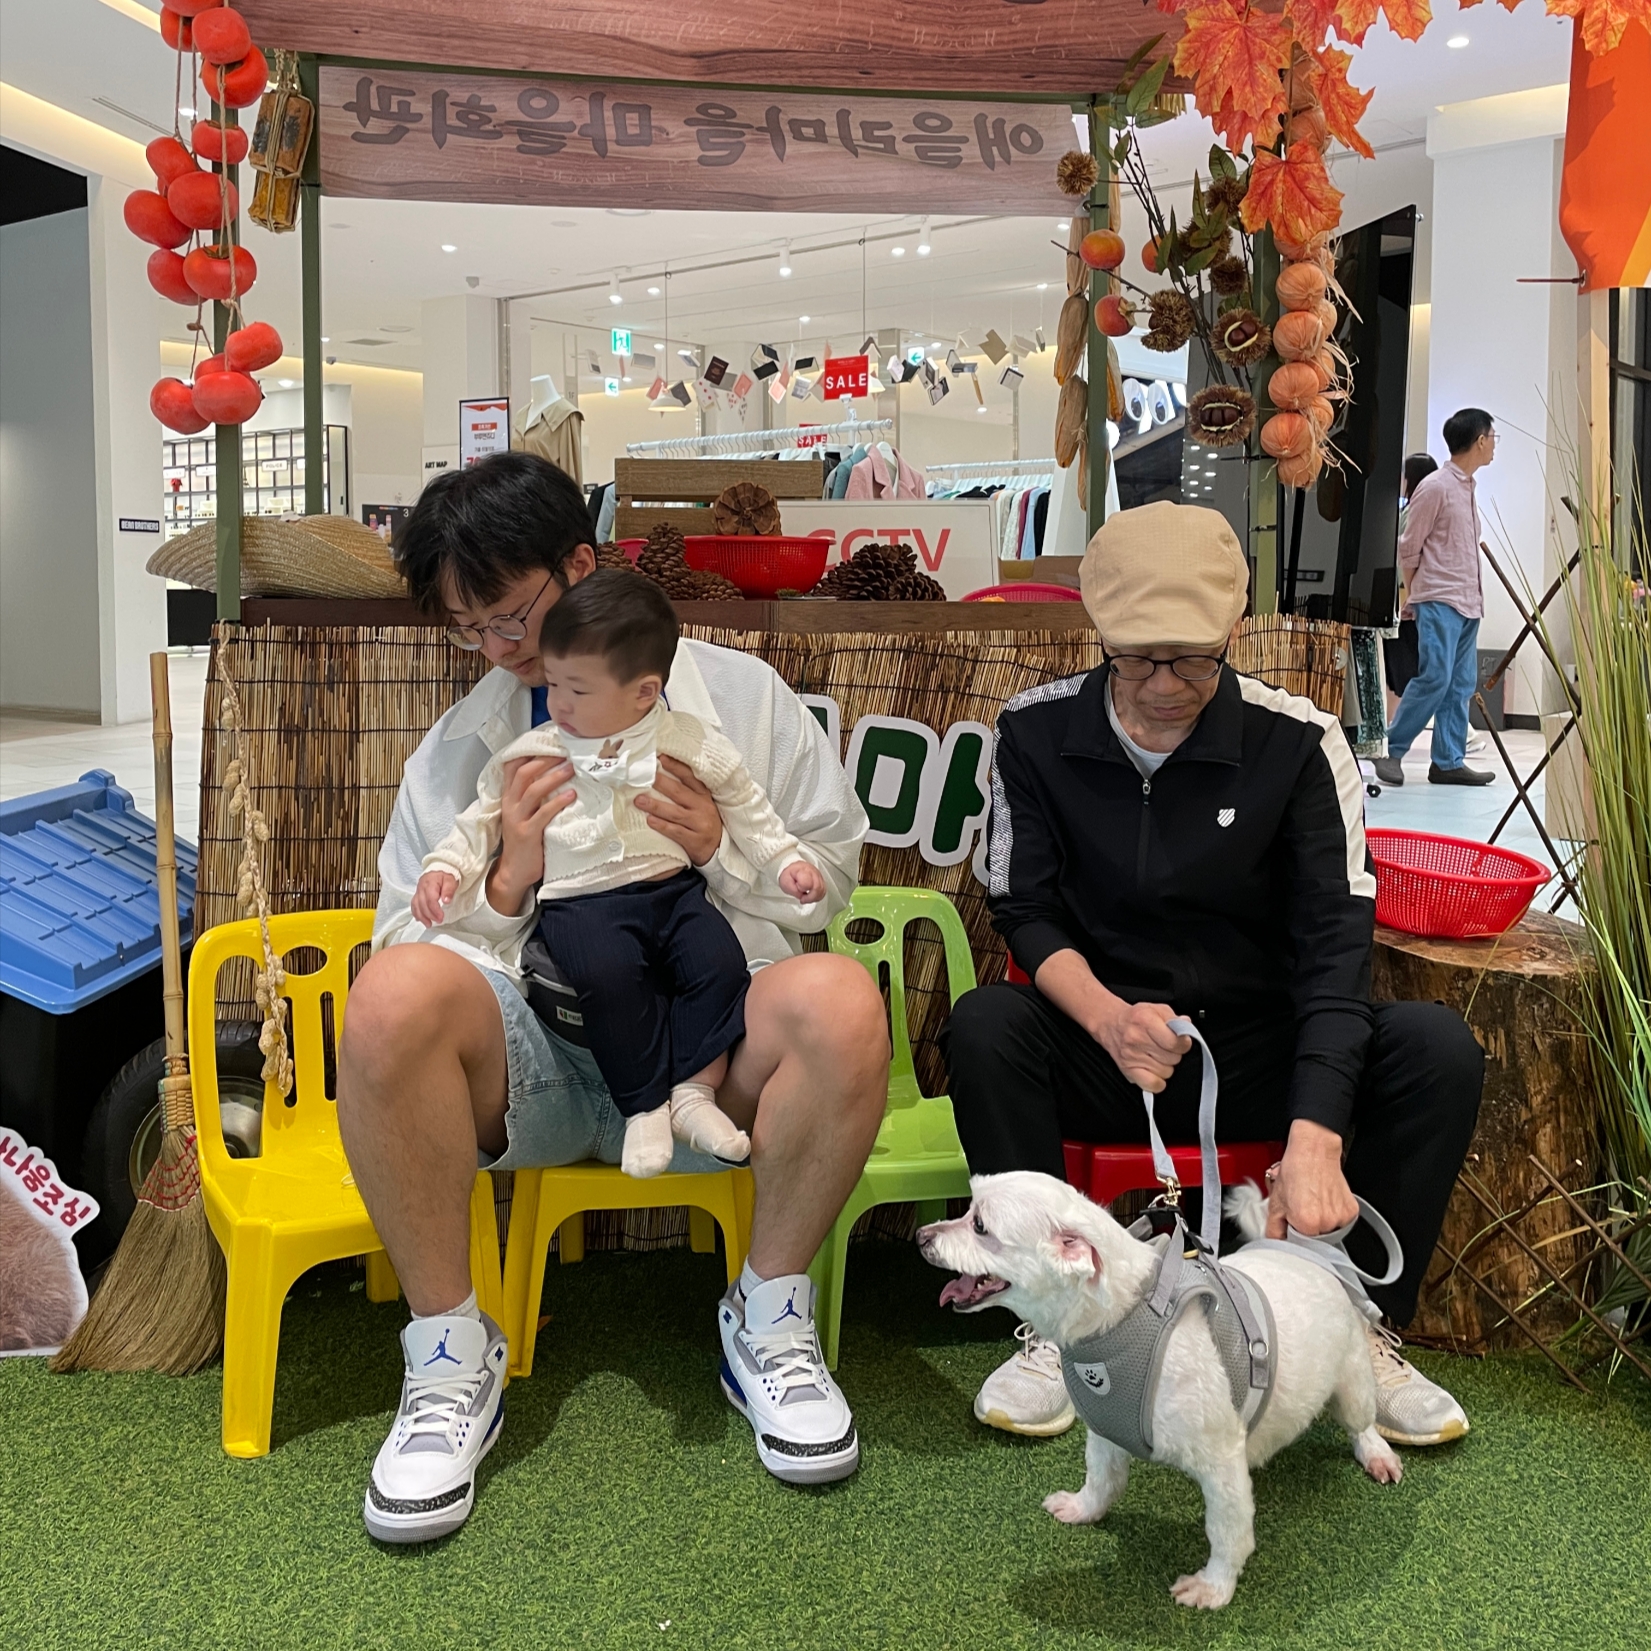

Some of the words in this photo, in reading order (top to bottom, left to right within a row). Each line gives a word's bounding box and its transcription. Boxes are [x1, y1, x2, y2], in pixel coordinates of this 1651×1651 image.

[826, 373, 867, 390] SALE
[798, 434, 827, 448] SALE
[425, 461, 435, 469] ART
